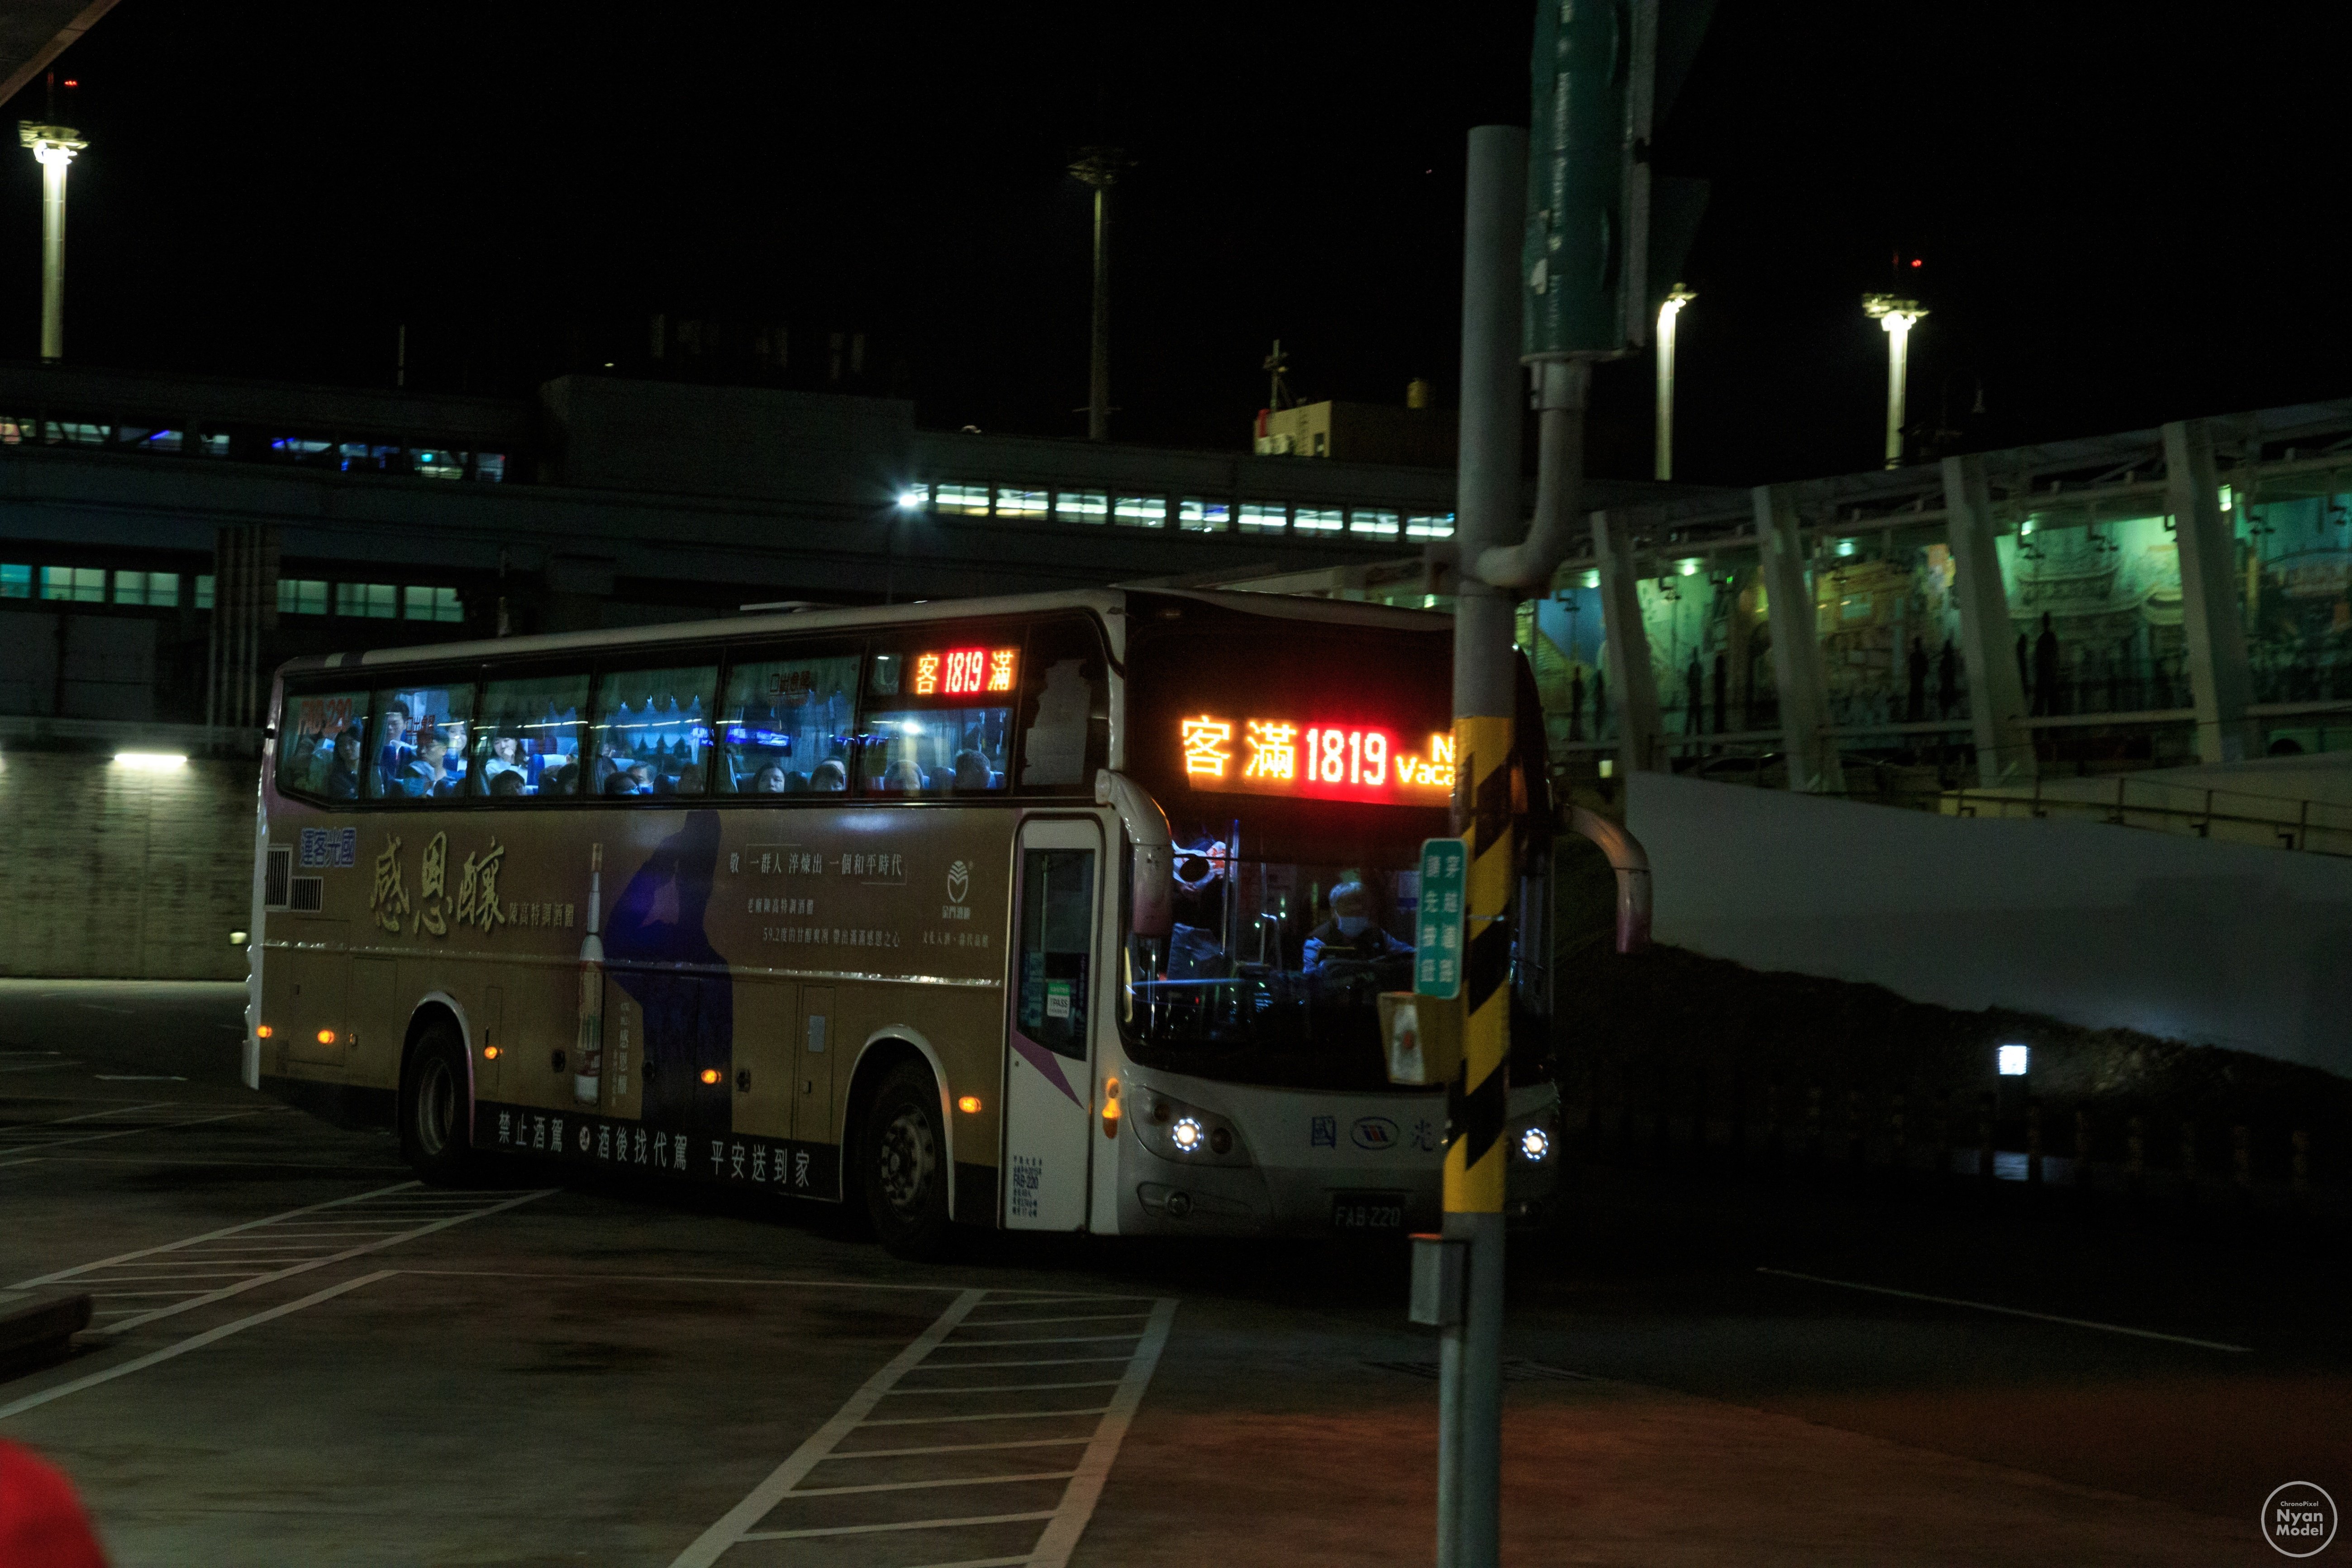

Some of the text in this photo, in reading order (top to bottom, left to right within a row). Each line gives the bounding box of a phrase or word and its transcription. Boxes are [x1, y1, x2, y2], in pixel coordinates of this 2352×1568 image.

[916, 651, 1014, 694] 客 1819 滿
[1306, 728, 1387, 785] 1819
[1433, 735, 1456, 763] N
[1395, 756, 1456, 786] Vaca
[370, 831, 505, 936] 感恩釀
[750, 853, 782, 874] 一群人
[499, 1110, 563, 1152] 禁止酒駕
[597, 1125, 688, 1171] 酒後找代駕
[710, 1139, 810, 1188] 平安送到家
